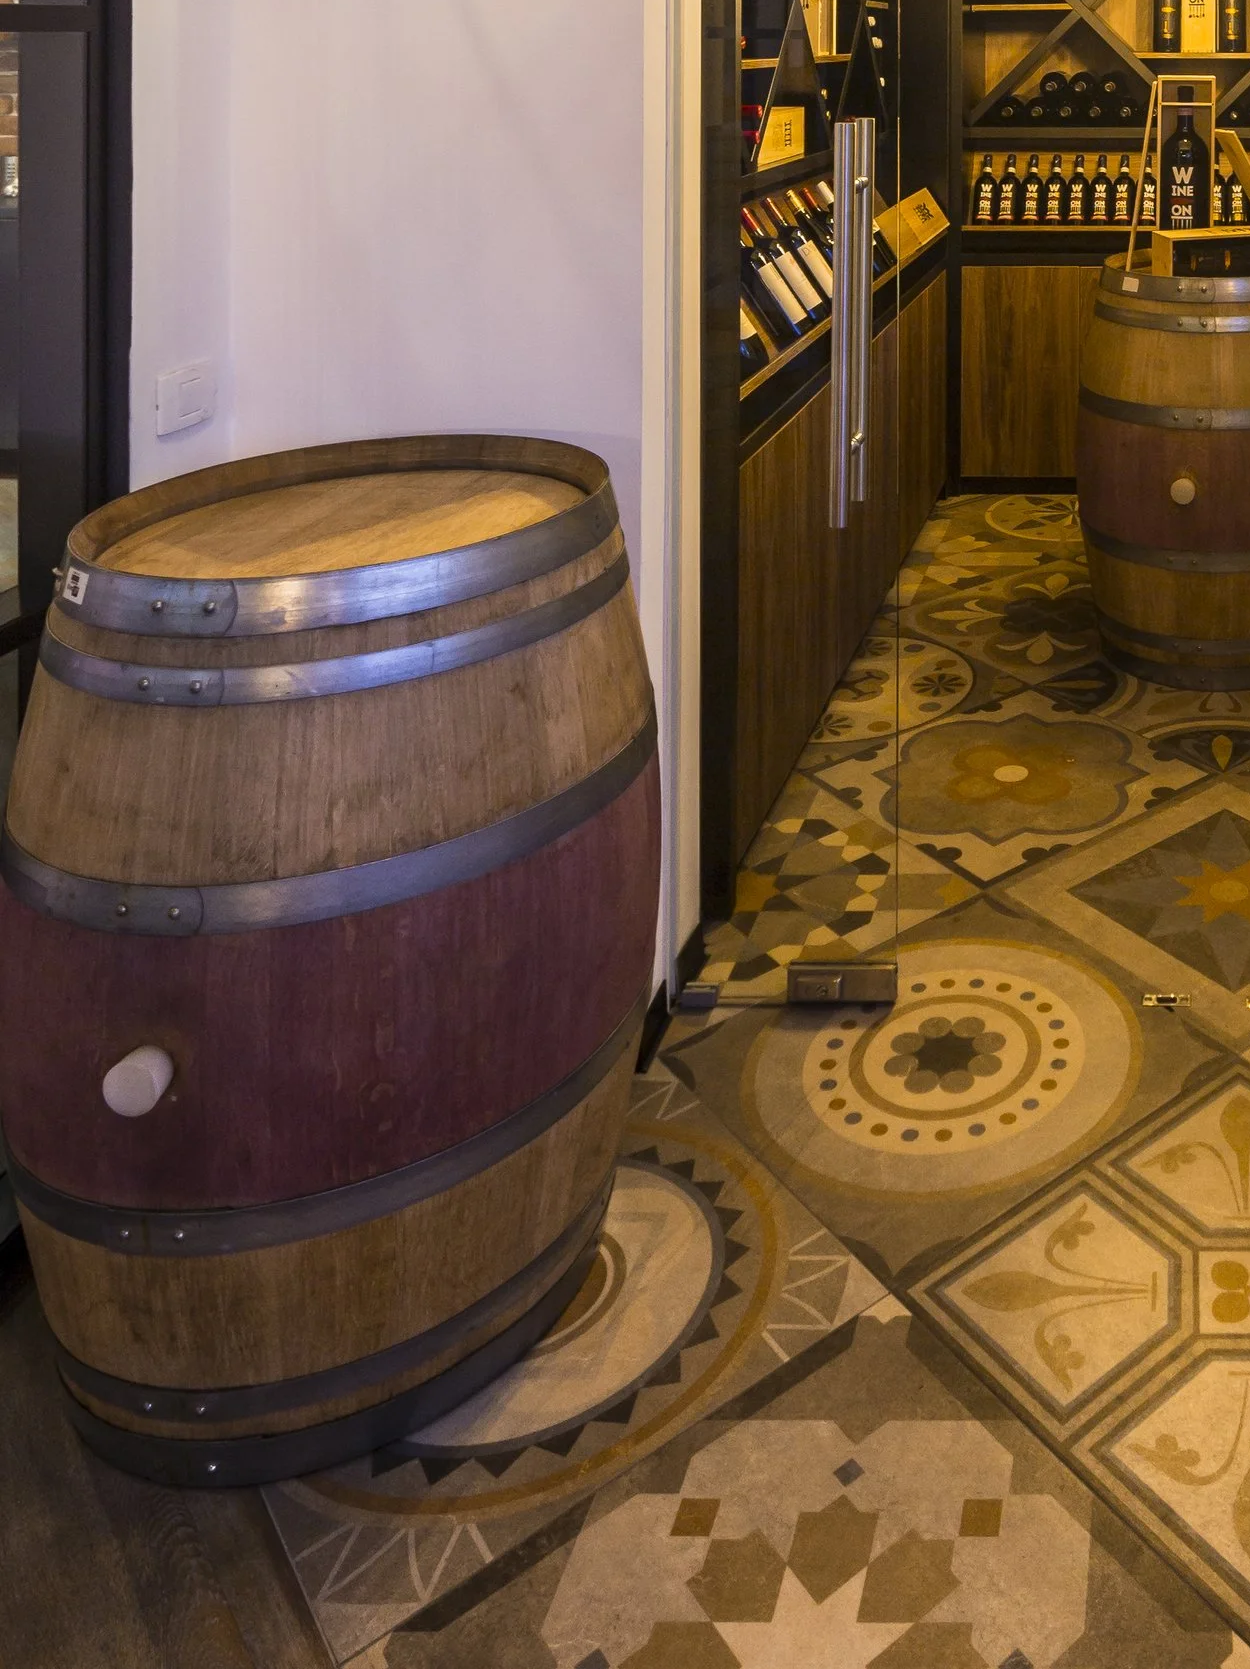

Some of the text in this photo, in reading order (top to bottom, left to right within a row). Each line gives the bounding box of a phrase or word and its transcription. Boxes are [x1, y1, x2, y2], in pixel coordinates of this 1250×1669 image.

[1172, 167, 1194, 184] W
[981, 184, 993, 192] W
[1002, 184, 1013, 192] W
[1027, 184, 1038, 192] W
[1049, 184, 1060, 192] W
[1071, 184, 1083, 192] W
[1095, 184, 1106, 192] W
[1116, 184, 1128, 192] W
[1144, 184, 1155, 192] W
[1171, 185, 1194, 197] INE
[1171, 205, 1192, 216] ON
